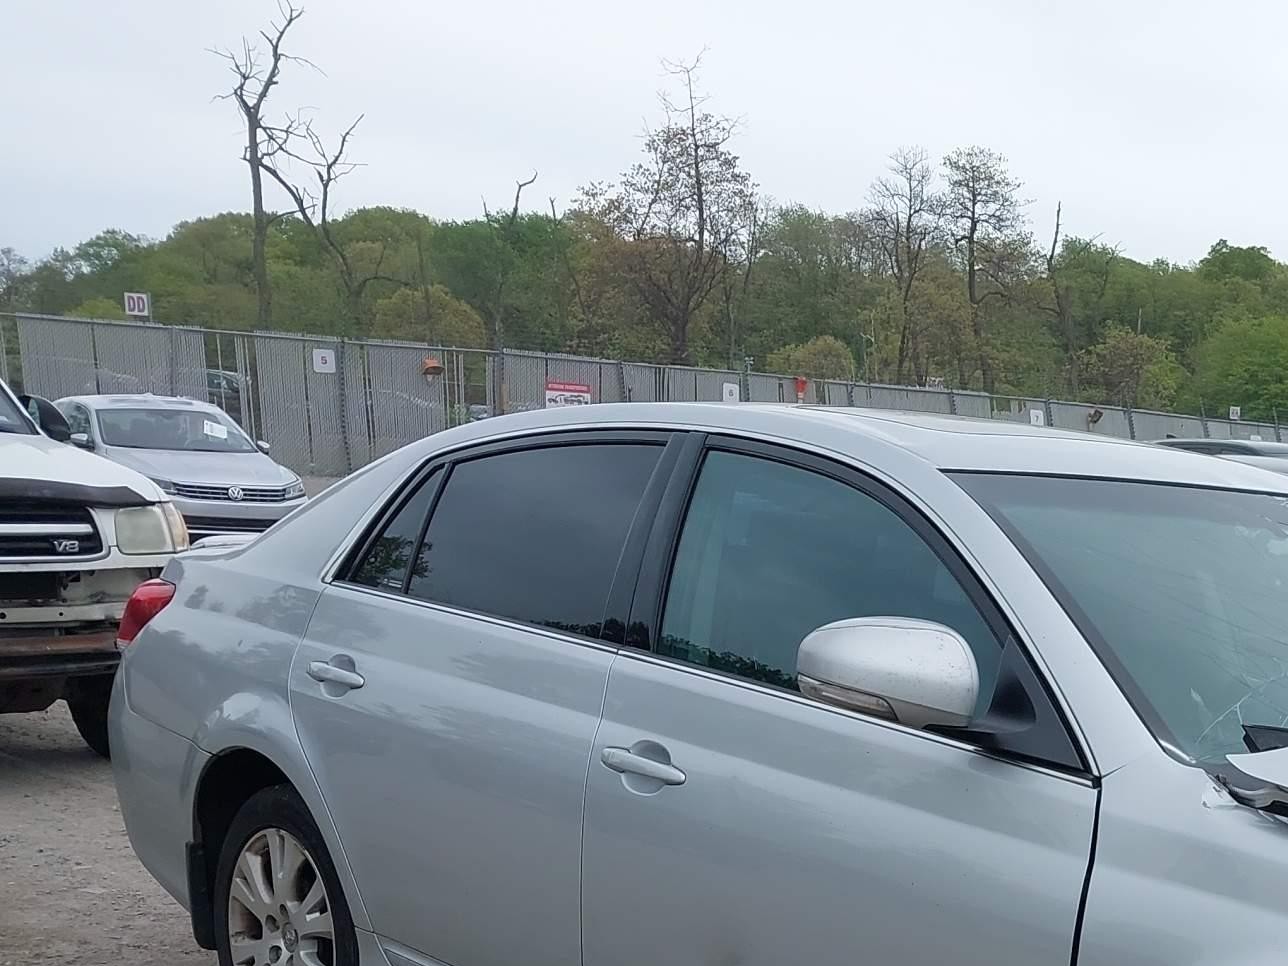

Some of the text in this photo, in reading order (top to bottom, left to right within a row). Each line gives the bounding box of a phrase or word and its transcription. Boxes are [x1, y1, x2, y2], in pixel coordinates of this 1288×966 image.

[127, 295, 146, 313] DD
[321, 356, 328, 365] 5
[53, 540, 79, 553] V8
